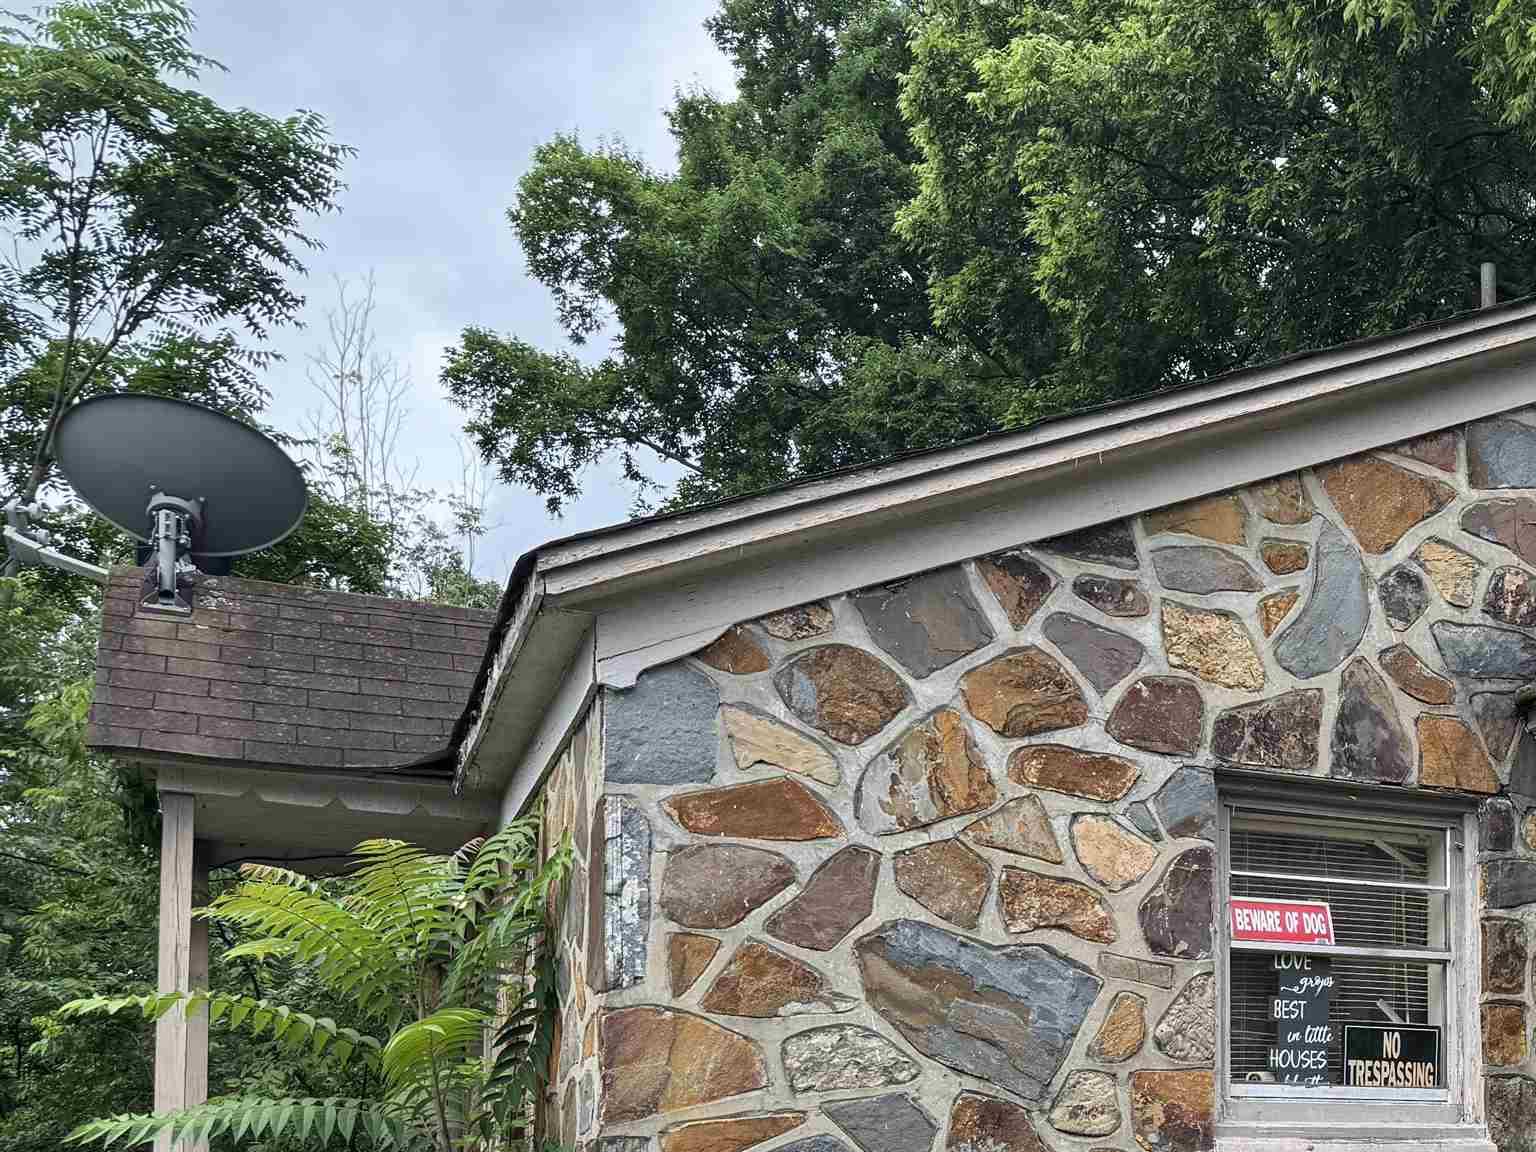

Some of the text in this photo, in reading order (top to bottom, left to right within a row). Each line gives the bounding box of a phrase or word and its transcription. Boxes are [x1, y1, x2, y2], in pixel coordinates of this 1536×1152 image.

[1235, 909, 1327, 935] BEWARE OF DOG
[1274, 952, 1312, 970] LOVE
[1274, 999, 1308, 1020] BEST
[1287, 1024, 1334, 1044] in little
[1383, 1031, 1401, 1059] NO
[1269, 1047, 1328, 1070] HOUSES
[1348, 1060, 1434, 1087] TRESPASSING
